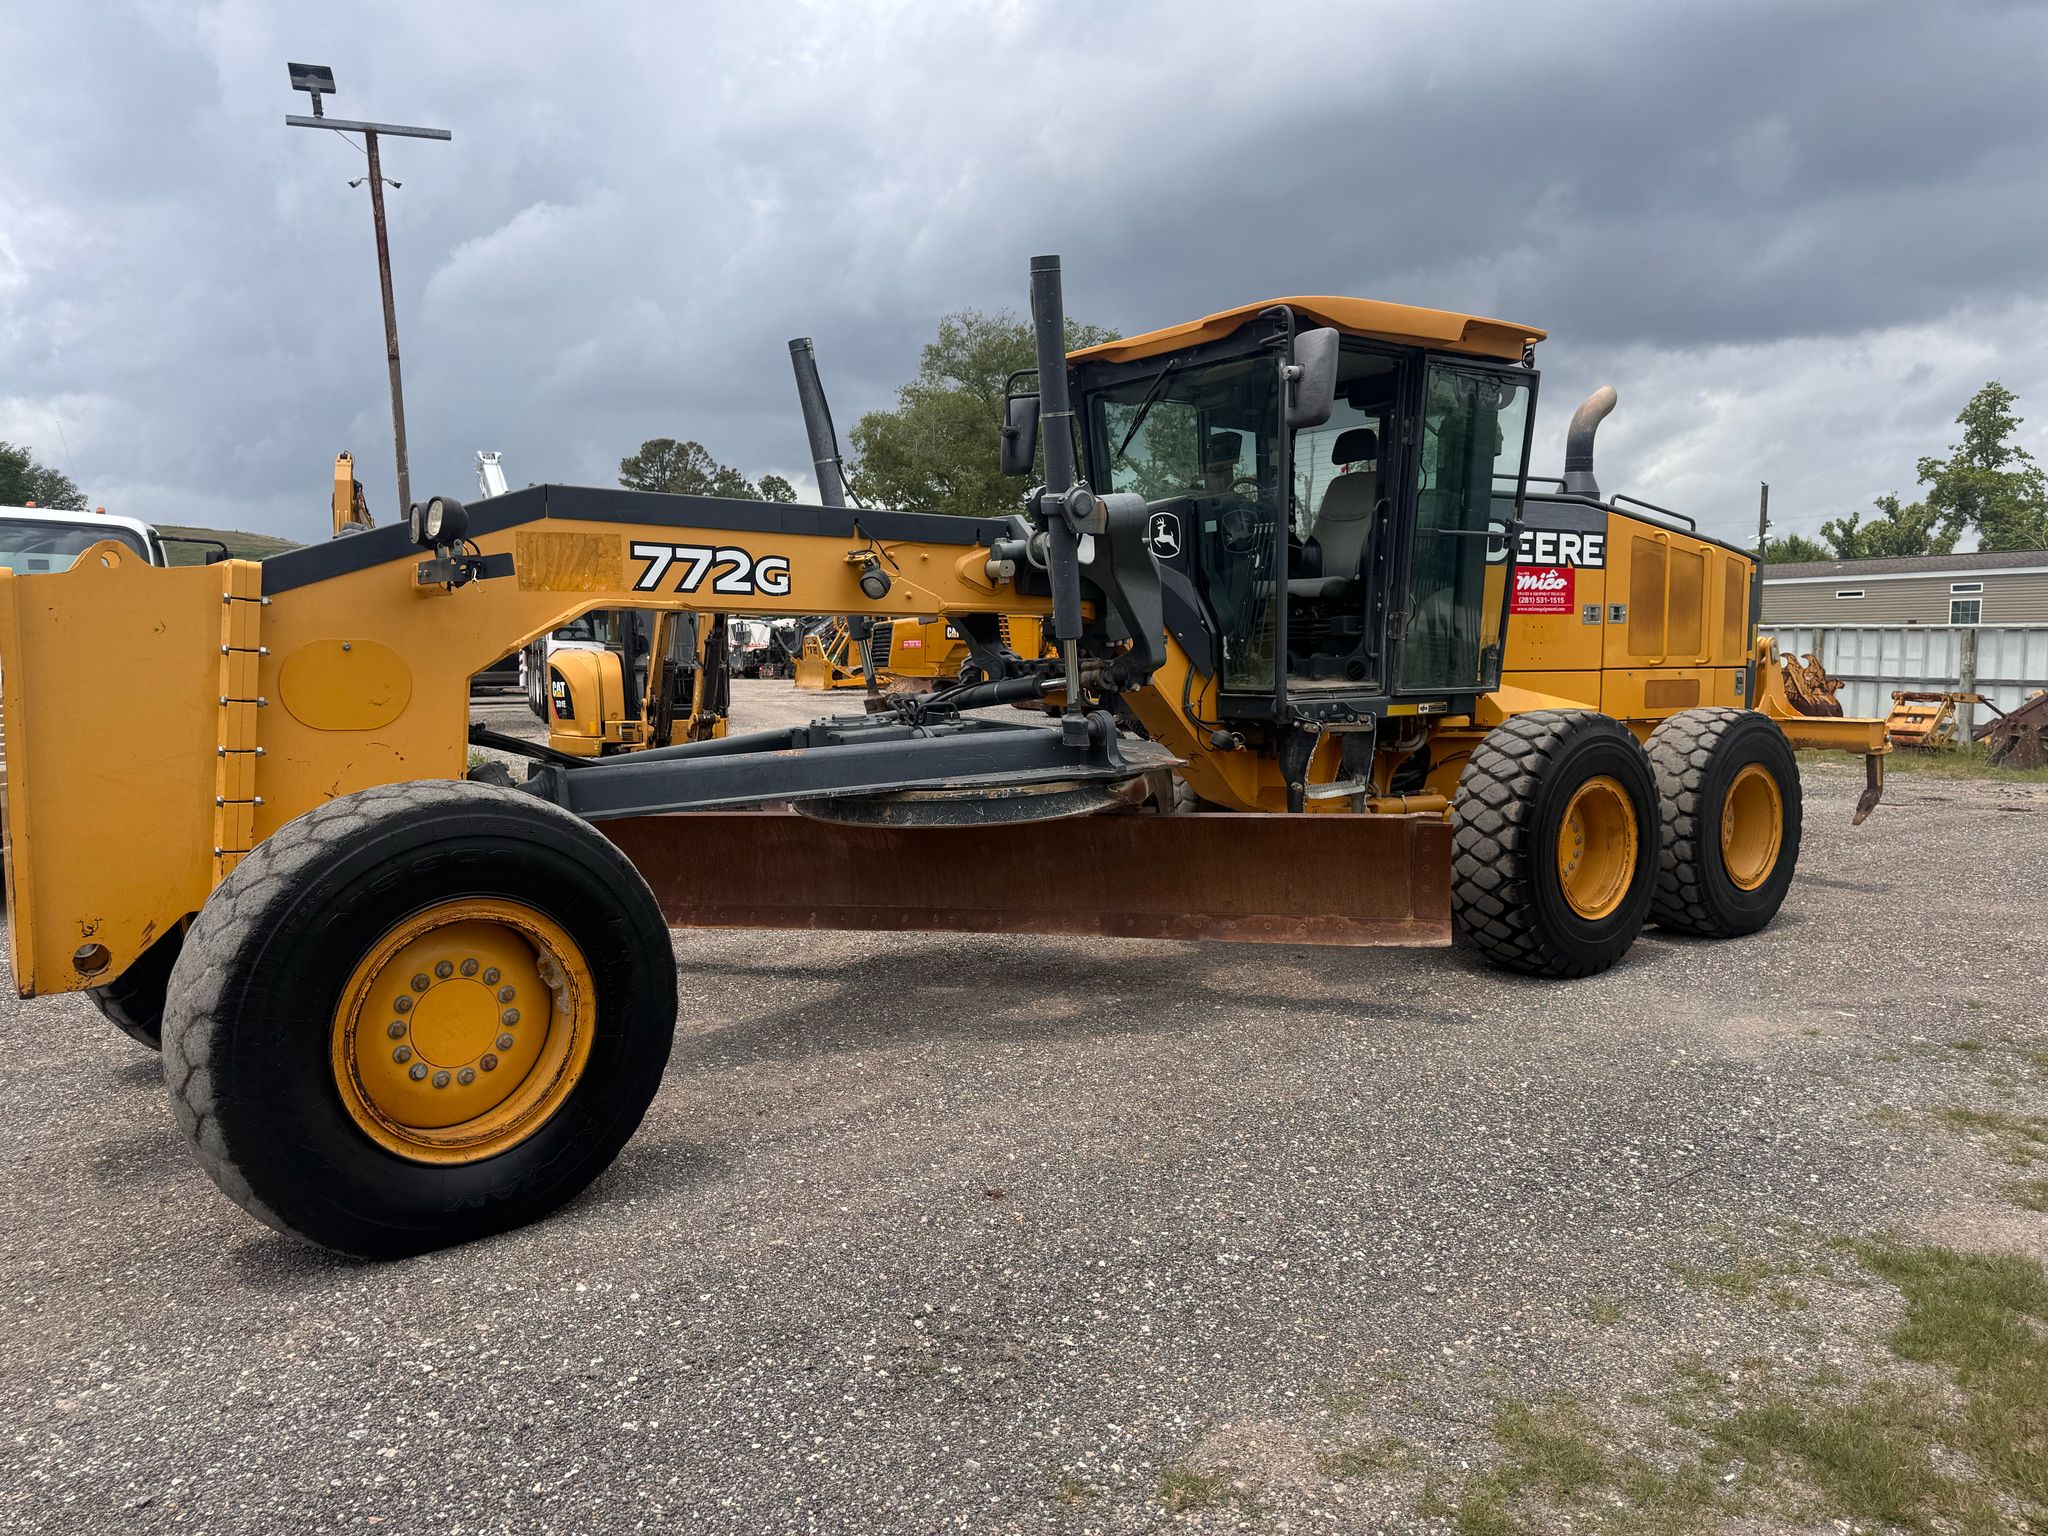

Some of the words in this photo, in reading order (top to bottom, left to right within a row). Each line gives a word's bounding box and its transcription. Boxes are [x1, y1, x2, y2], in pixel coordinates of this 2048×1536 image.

[1486, 522, 1604, 566] DEERE
[631, 542, 791, 596] 772G
[552, 681, 565, 697] CAT
